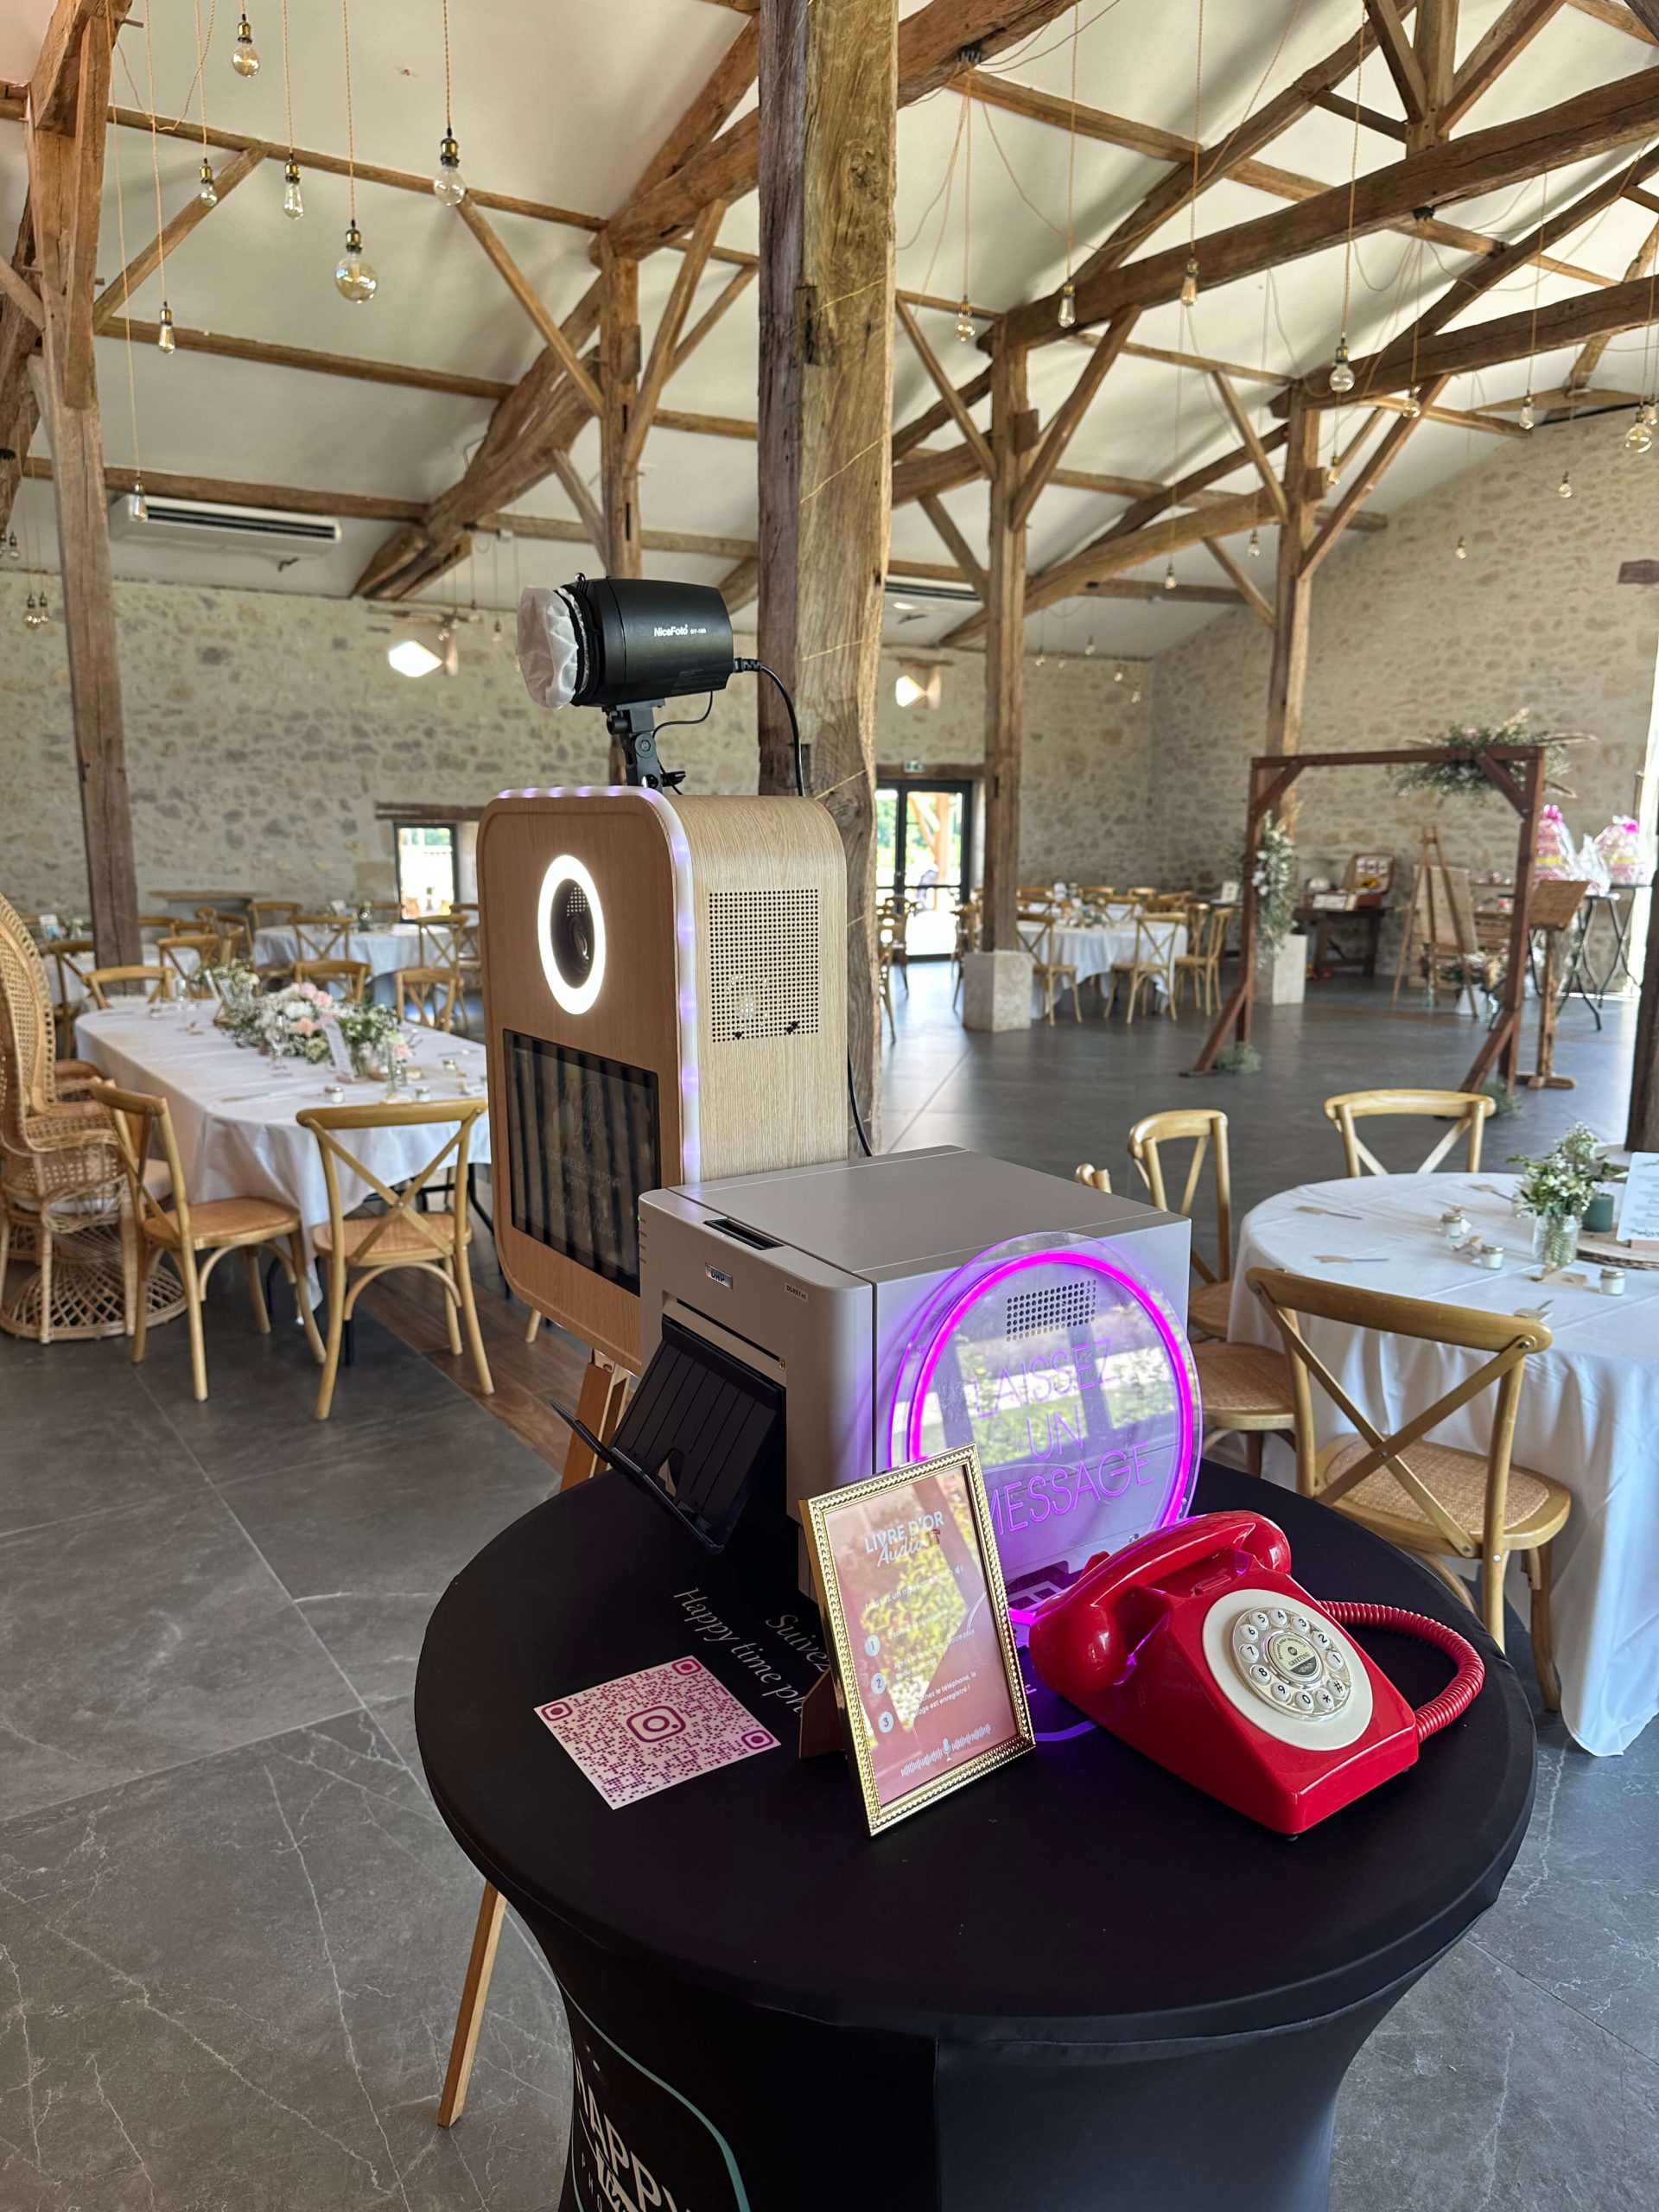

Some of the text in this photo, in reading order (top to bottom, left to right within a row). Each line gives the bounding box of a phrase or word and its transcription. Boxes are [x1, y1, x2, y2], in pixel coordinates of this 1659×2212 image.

[974, 1338, 1119, 1419] LAISSEZ
[1027, 1405, 1083, 1461] UN
[864, 1511, 944, 1554] LIVRE D'OR
[1277, 1611, 1284, 1619] 4
[1299, 1618, 1306, 1627] 3
[673, 1587, 740, 1641] Happy
[731, 1642, 781, 1683] time
[1318, 1634, 1327, 1643] 2
[1247, 1646, 1255, 1656] 7
[1332, 1654, 1340, 1662] 1
[1259, 1668, 1268, 1676] 8
[1278, 1685, 1285, 1694] 9
[1302, 1694, 1311, 1704] 0
